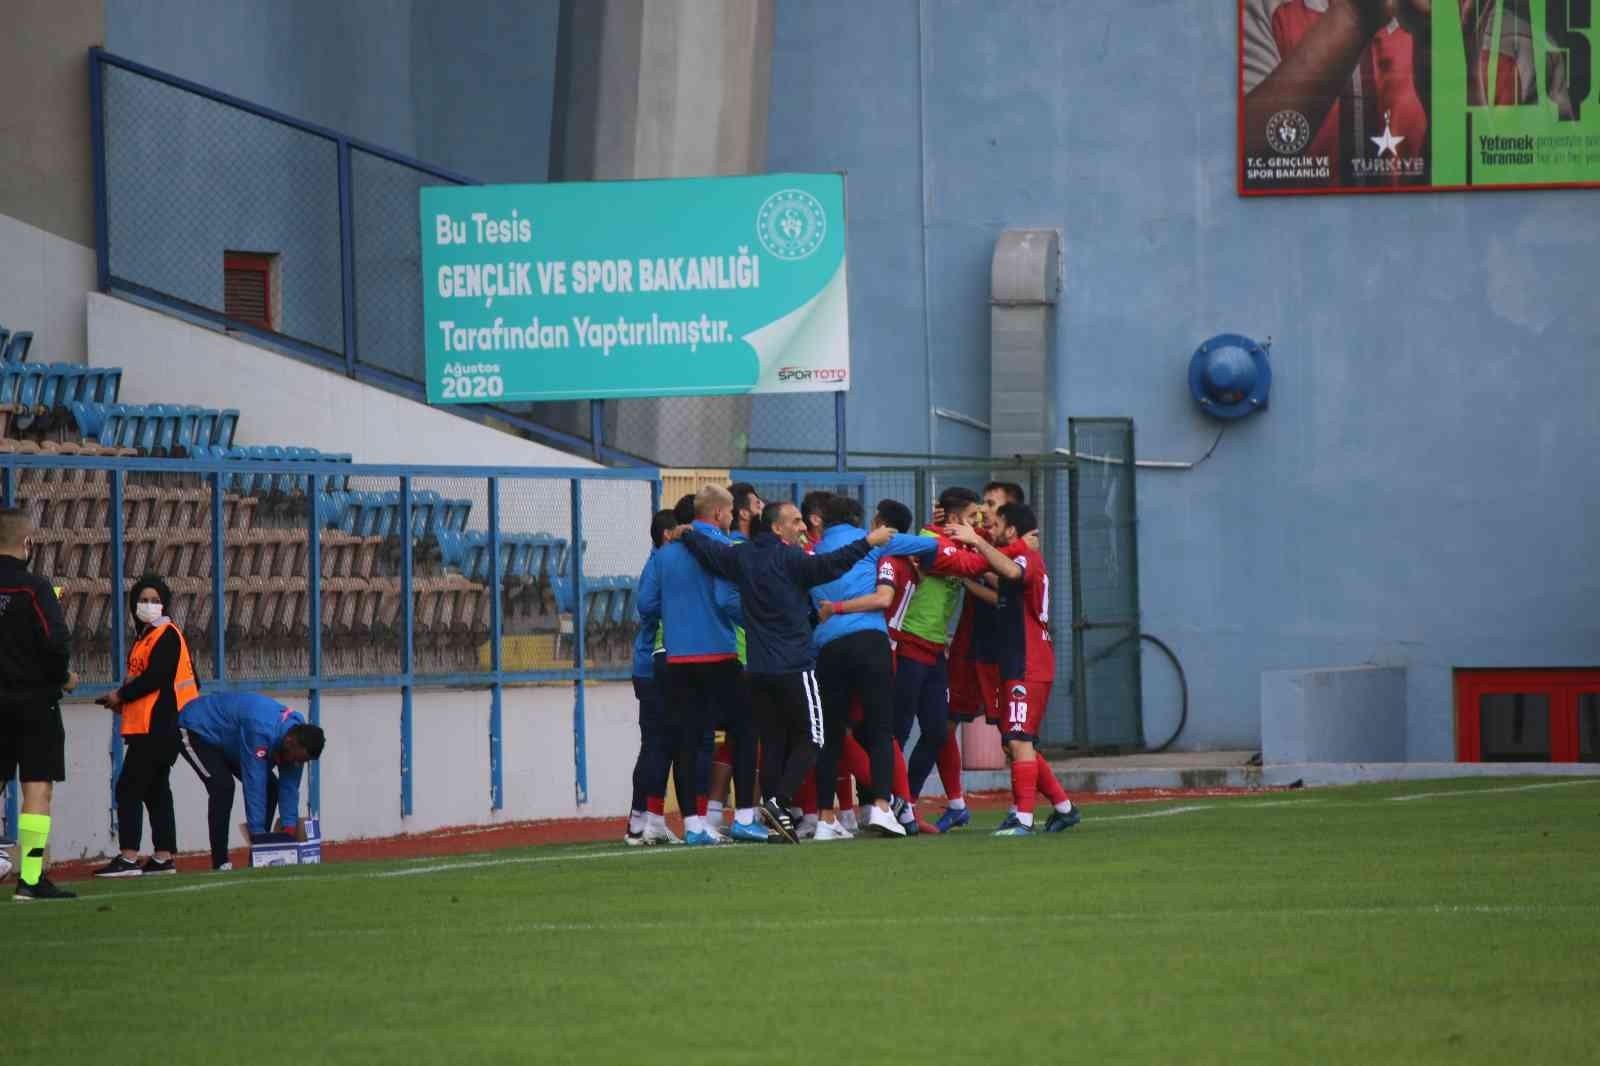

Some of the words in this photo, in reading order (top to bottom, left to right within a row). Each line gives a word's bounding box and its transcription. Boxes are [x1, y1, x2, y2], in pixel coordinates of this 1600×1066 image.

[1459, 0, 1600, 121] YAŞ
[1480, 134, 1534, 151] Yetenek
[1247, 158, 1266, 167] T.C.
[1268, 157, 1313, 168] GENÇLİK
[1316, 156, 1329, 166] VE
[1247, 169, 1274, 179] SPOR
[1275, 167, 1330, 179] BAKANLIĞI
[436, 213, 467, 245] Bu
[471, 209, 532, 243] Tesis
[536, 260, 567, 296] VE
[571, 258, 634, 296] SPOR
[639, 245, 760, 291] BAKANLIĞI
[439, 317, 569, 353] Tarafından
[572, 312, 734, 355] Yaptırılmıştır.
[444, 362, 500, 377] Ağustos
[441, 375, 504, 399] 2020
[1009, 701, 1028, 723] 18
